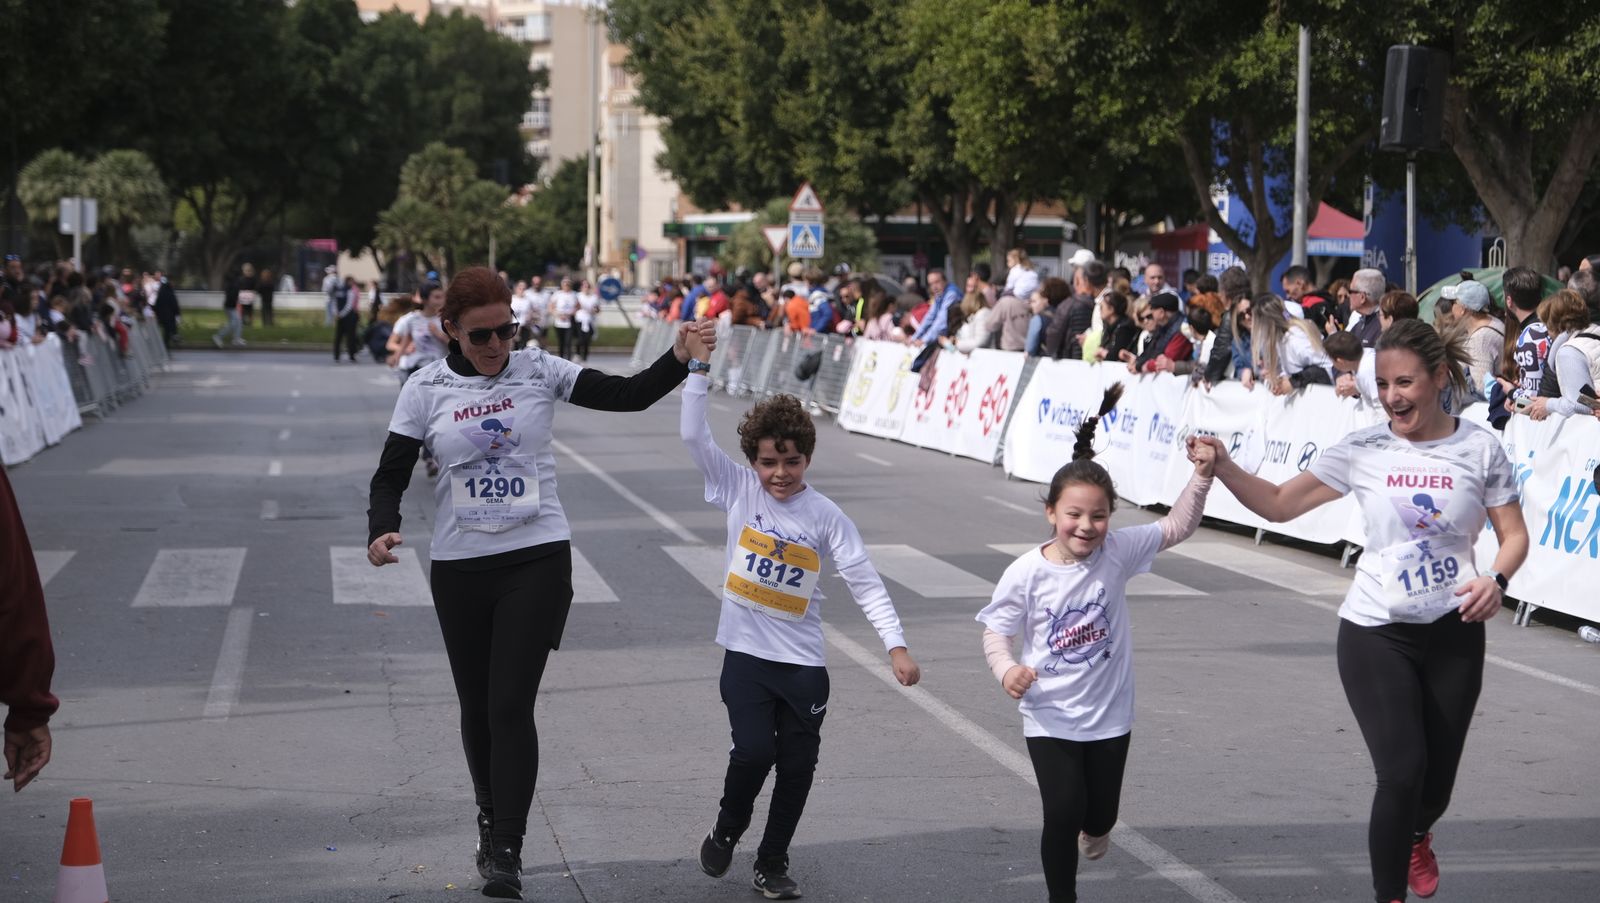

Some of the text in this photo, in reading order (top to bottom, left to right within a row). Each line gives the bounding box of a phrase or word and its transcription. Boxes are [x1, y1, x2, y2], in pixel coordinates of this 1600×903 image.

[453, 398, 514, 423] MUJER
[1391, 465, 1427, 473] CARRERA
[465, 477, 525, 498] 1290
[1387, 474, 1454, 490] MUJER
[745, 552, 805, 588] 1812
[1398, 556, 1459, 591] 1159
[759, 577, 779, 588] DAVID
[1432, 584, 1444, 593] DEL
[1055, 627, 1107, 650] RUNNER
[1065, 622, 1096, 638] MINI
